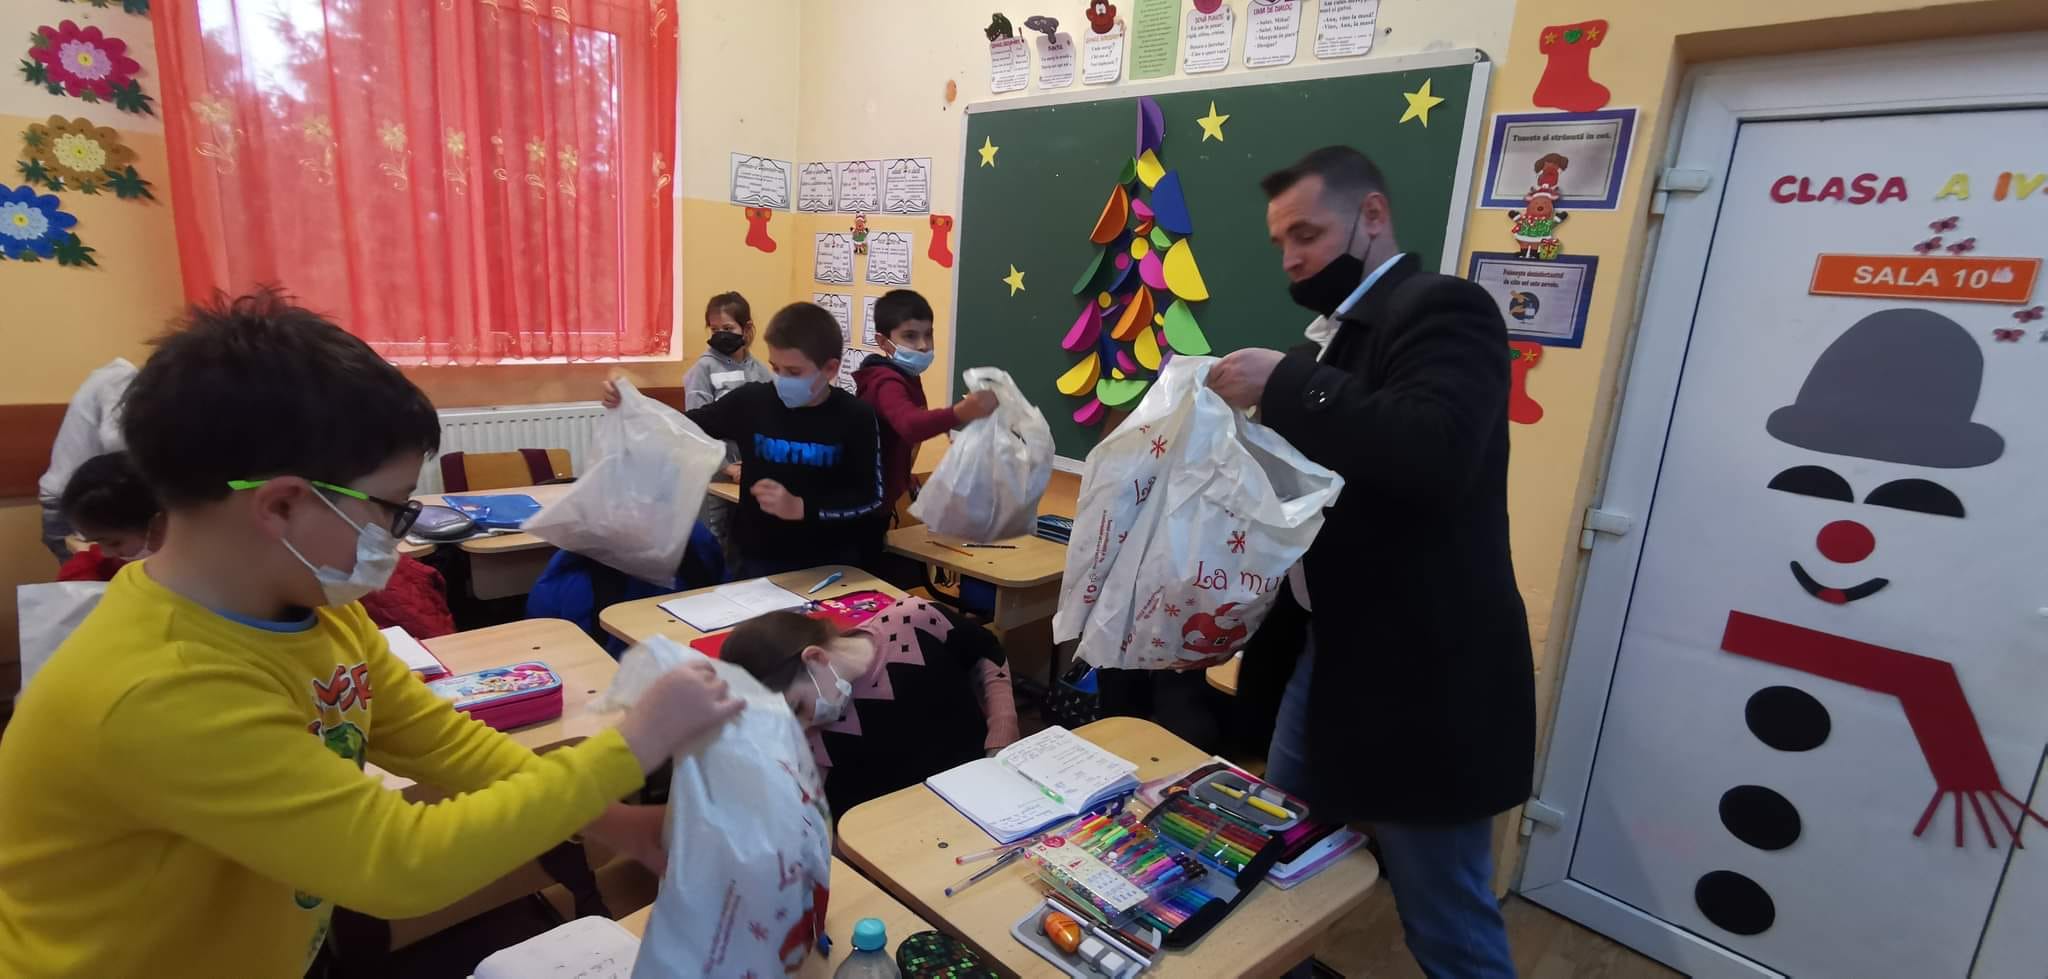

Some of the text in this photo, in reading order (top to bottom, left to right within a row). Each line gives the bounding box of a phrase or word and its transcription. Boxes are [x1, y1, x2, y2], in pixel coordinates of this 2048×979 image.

[1770, 173, 1908, 205] CLASA
[1935, 172, 1970, 202] A
[1853, 265, 1989, 289] SALA 10
[1192, 560, 1229, 590] La
